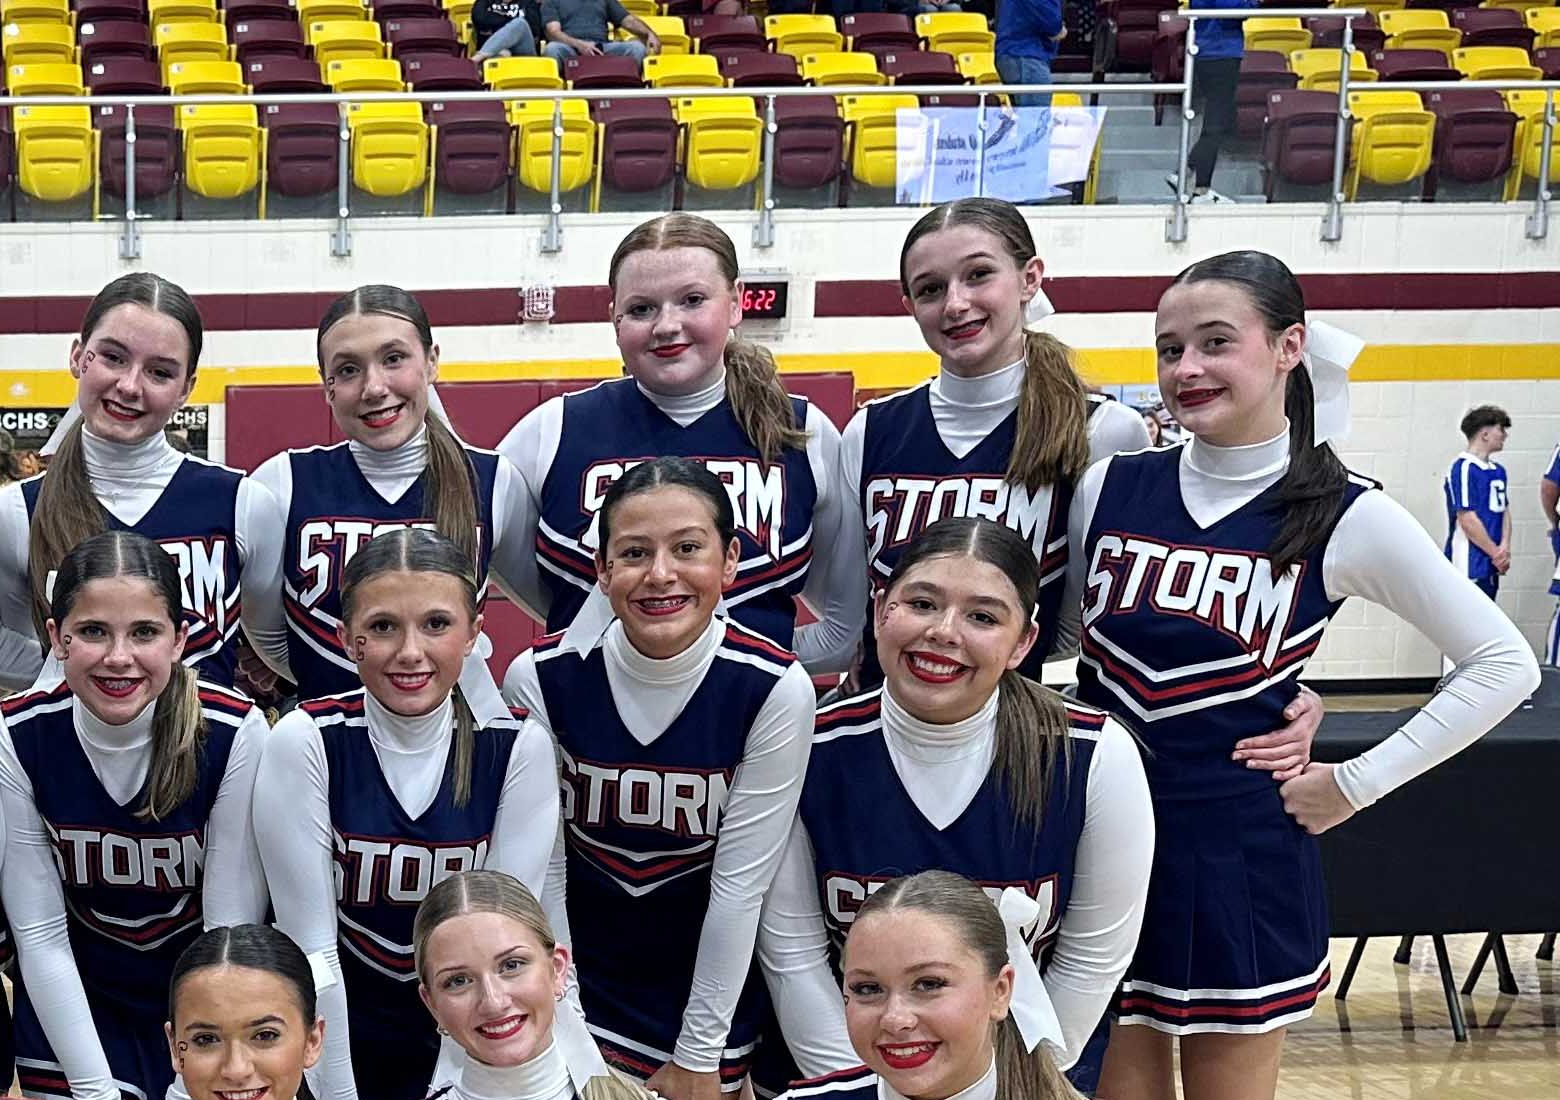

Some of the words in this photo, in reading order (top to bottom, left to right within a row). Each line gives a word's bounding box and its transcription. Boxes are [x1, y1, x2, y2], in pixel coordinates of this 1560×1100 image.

[582, 460, 783, 561] SRM
[1489, 480, 1507, 513] G
[1082, 534, 1302, 669] STORM
